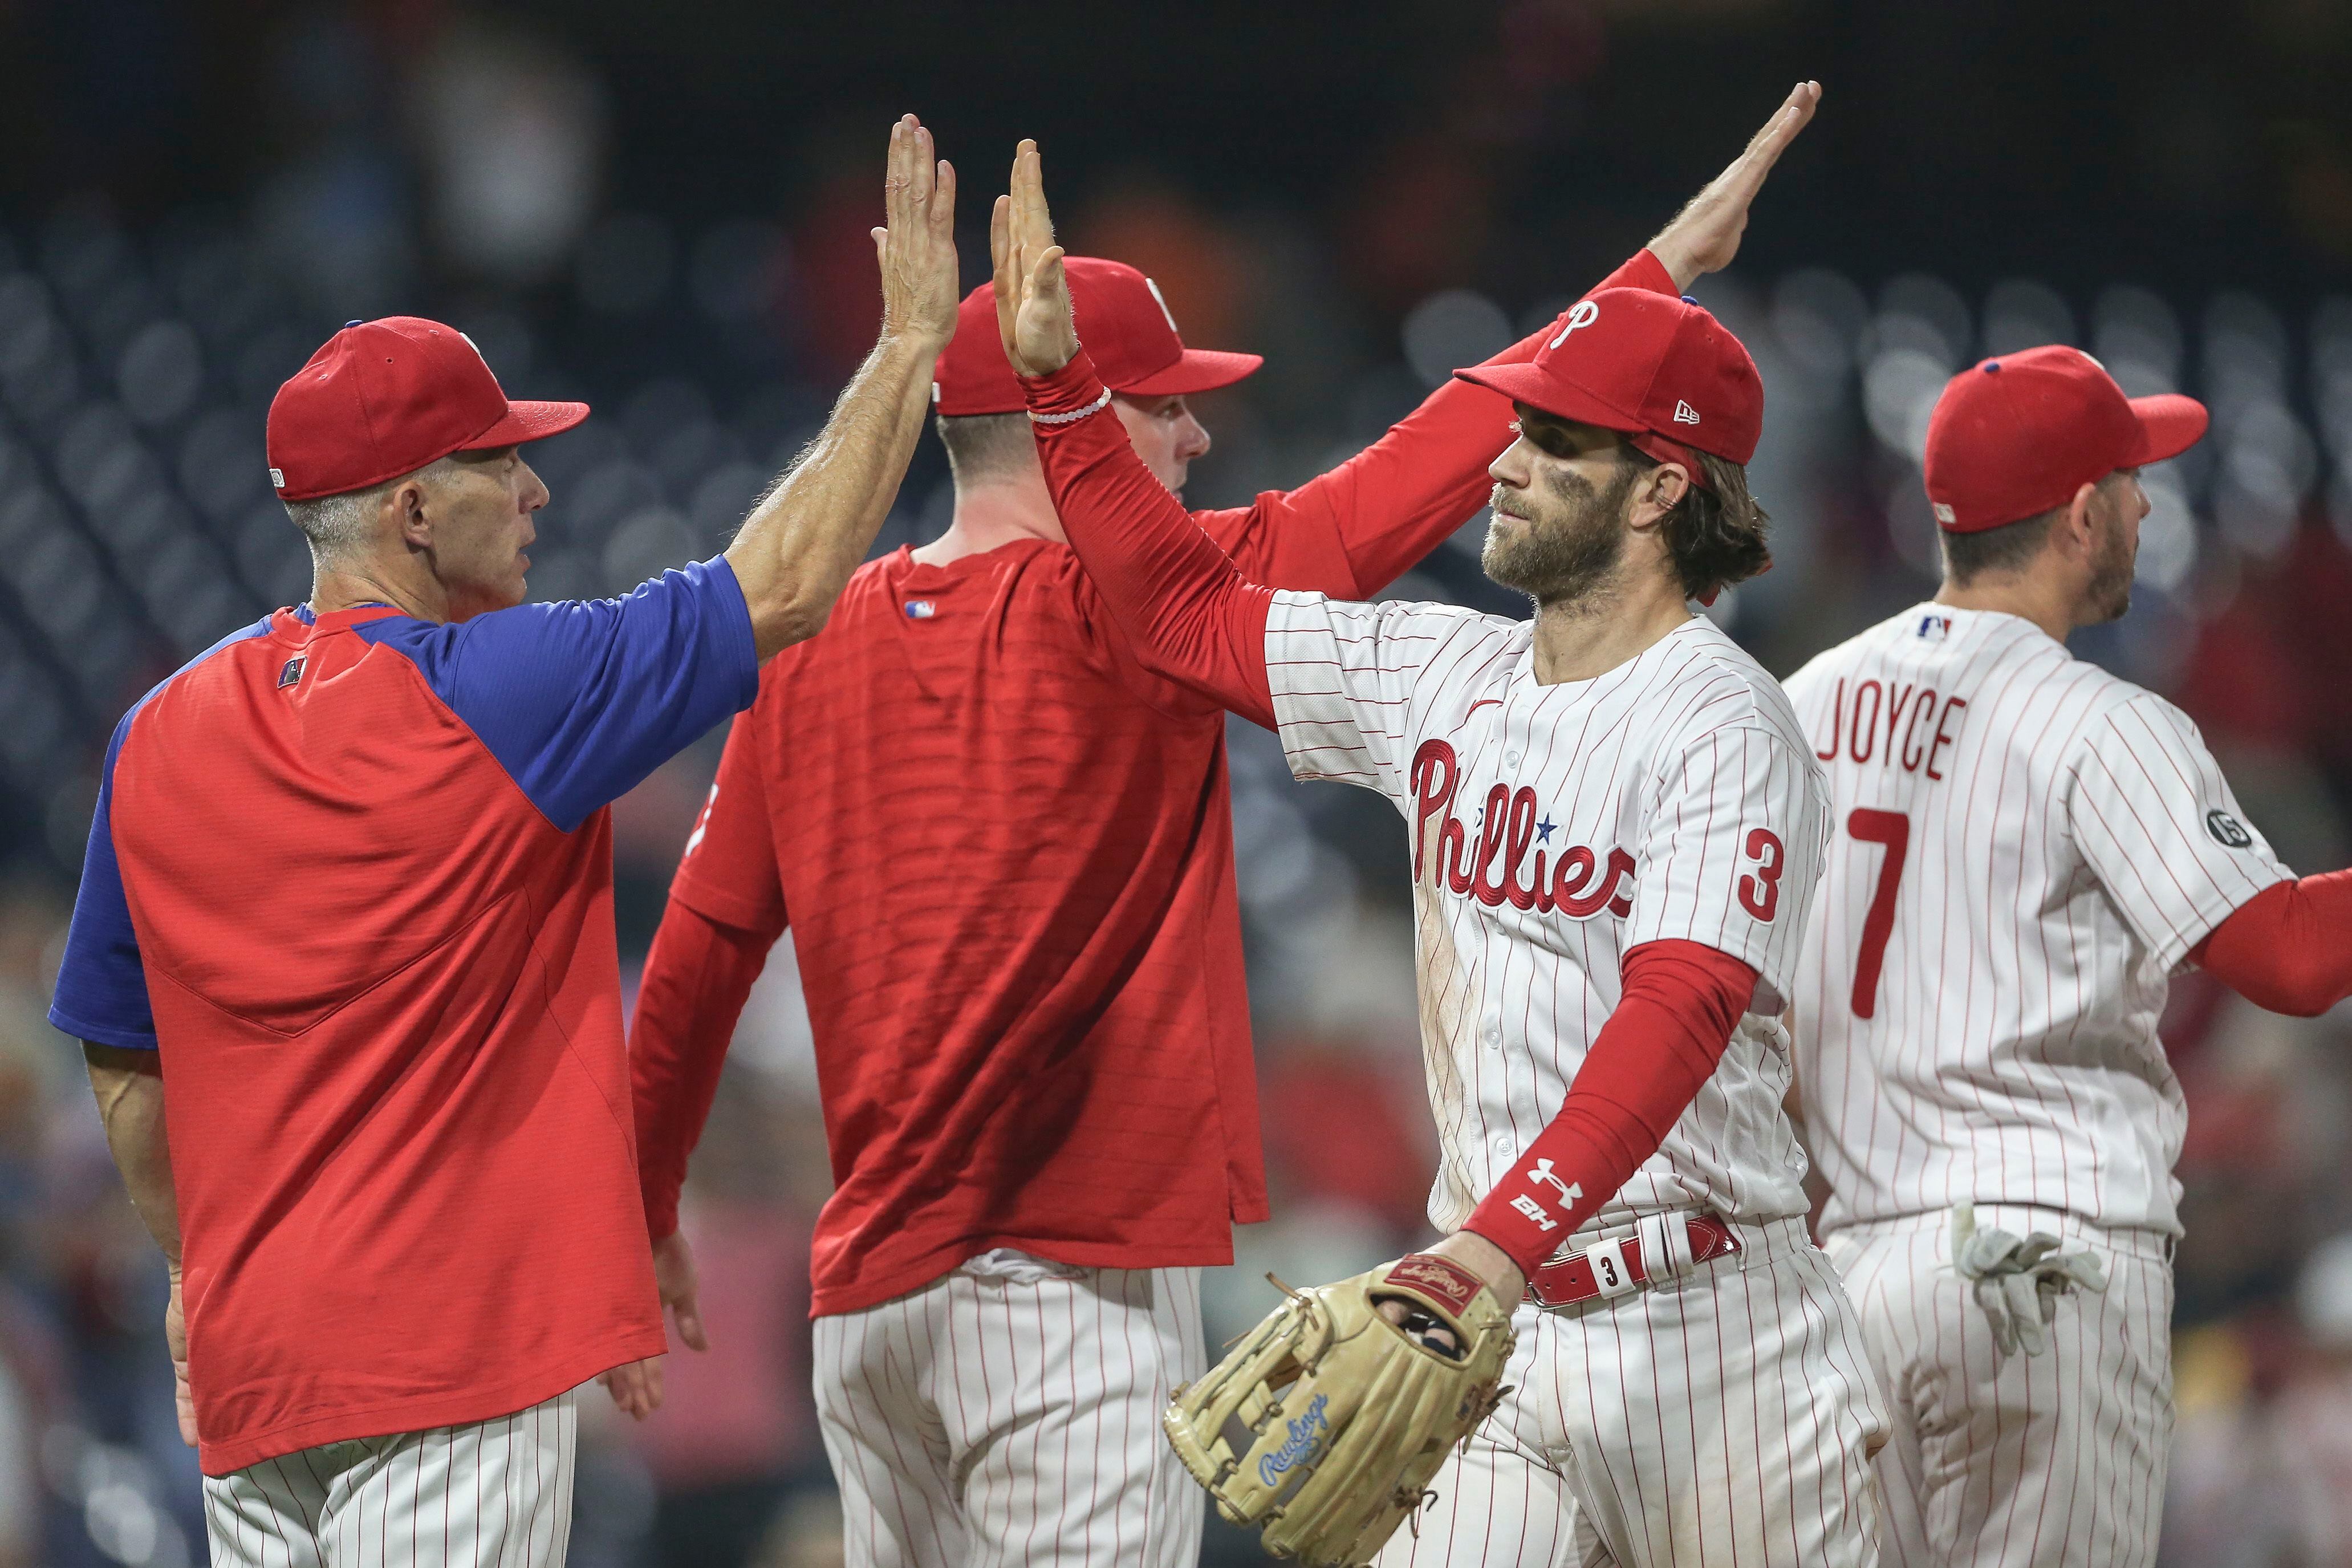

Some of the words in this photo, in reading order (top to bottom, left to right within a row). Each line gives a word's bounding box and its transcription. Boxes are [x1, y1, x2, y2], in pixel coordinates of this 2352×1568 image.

[1549, 300, 1599, 351] P
[1817, 676, 1965, 781] JOYCE
[1738, 828, 1785, 923] 3
[1848, 807, 1909, 1019] 7
[1509, 1193, 1558, 1232] BH
[1600, 1256, 1619, 1287] 3
[1258, 1393, 1329, 1487] Rawlings
